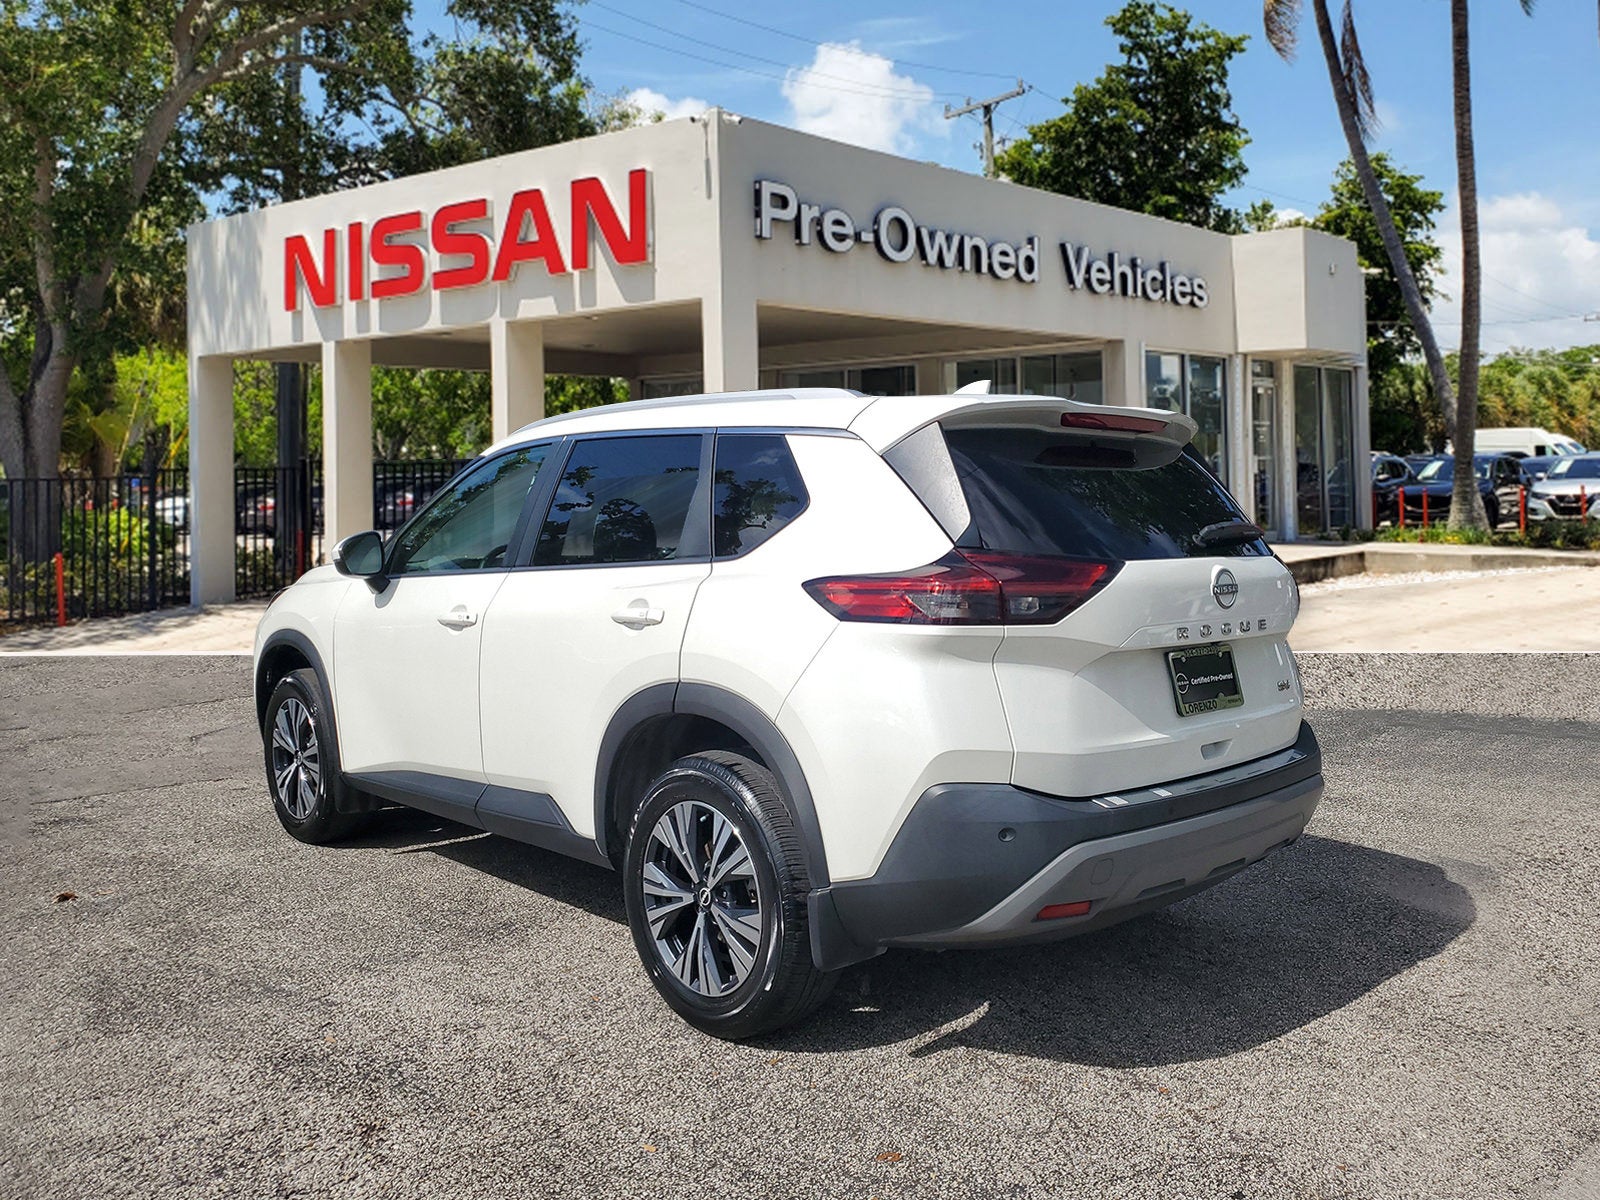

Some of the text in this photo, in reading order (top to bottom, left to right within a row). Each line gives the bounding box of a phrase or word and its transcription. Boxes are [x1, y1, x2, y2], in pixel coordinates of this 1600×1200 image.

[285, 168, 647, 311] NISSAN
[755, 180, 1209, 308] Pre-Owned Vehicles
[1176, 619, 1268, 641] ROGUE
[1190, 675, 1210, 685] Certified
[1210, 672, 1233, 682] Pre-Owned
[1184, 699, 1218, 714] LORENZO
